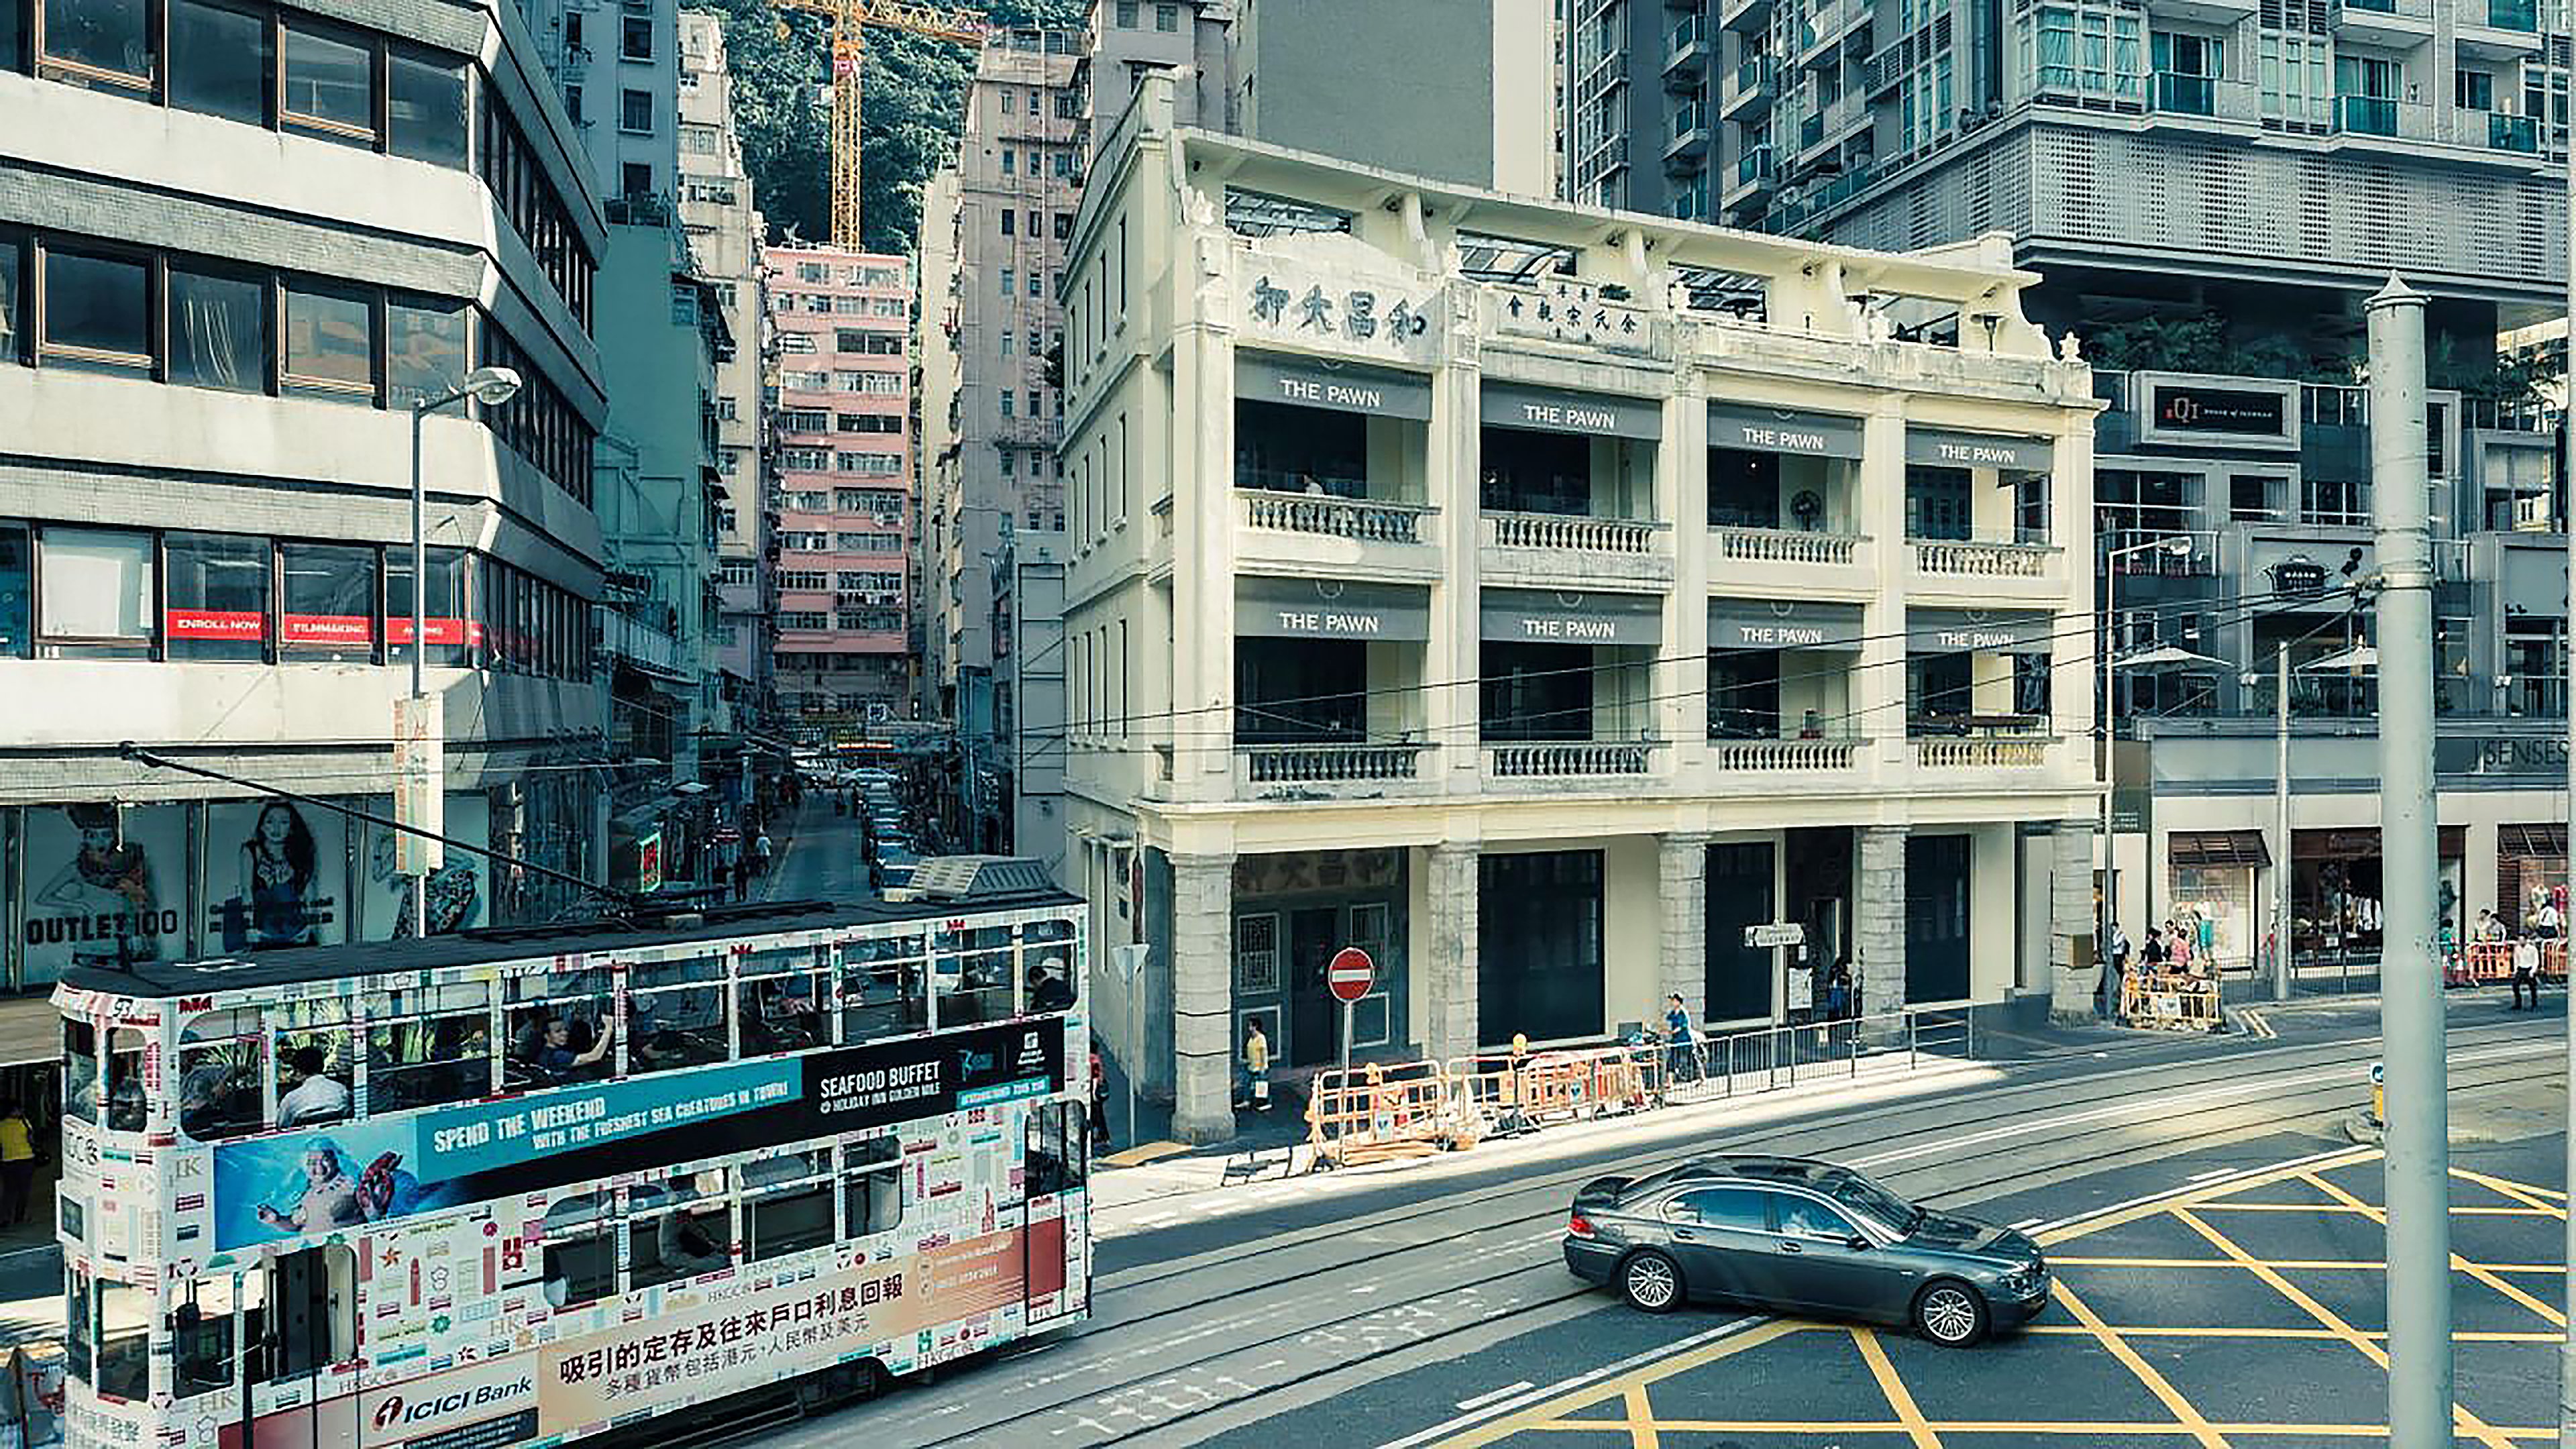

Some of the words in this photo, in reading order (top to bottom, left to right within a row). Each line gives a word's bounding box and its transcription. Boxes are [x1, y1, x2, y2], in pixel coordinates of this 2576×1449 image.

[1280, 380, 1320, 400] THE
[1328, 386, 1380, 407] PAWN
[1523, 405, 1560, 424] THE
[1566, 409, 1615, 429] PAWN
[1743, 428, 1775, 445] THE
[1780, 431, 1823, 449] PAWN
[1939, 445, 1970, 460] THE
[1974, 447, 2015, 464] PAWN
[178, 619, 227, 629] ENROLL
[230, 621, 260, 629] NOW
[292, 623, 366, 633] FILMMAKING
[1279, 612, 1319, 631] THE
[1326, 614, 1379, 633] PAWN
[1523, 620, 1560, 636] THE
[1566, 621, 1615, 638] PAWN
[1741, 628, 1774, 642] THE
[1778, 629, 1822, 644] PAWN
[1938, 633, 1969, 647] THE
[1973, 633, 2015, 647] PAWN
[820, 1071, 885, 1098] SEAFOOD
[889, 1061, 941, 1087] BUFFET
[433, 1122, 490, 1152] SPEND
[496, 1113, 526, 1140] THE
[531, 1097, 605, 1130] WEEKEND
[533, 1130, 566, 1150] WITH
[570, 1123, 591, 1142] THE
[594, 1110, 647, 1138] FRESHEST
[651, 1106, 672, 1124] SEA
[676, 1091, 735, 1118] CREATURES
[404, 1392, 470, 1424] ICICI
[475, 1377, 532, 1405] Bank
